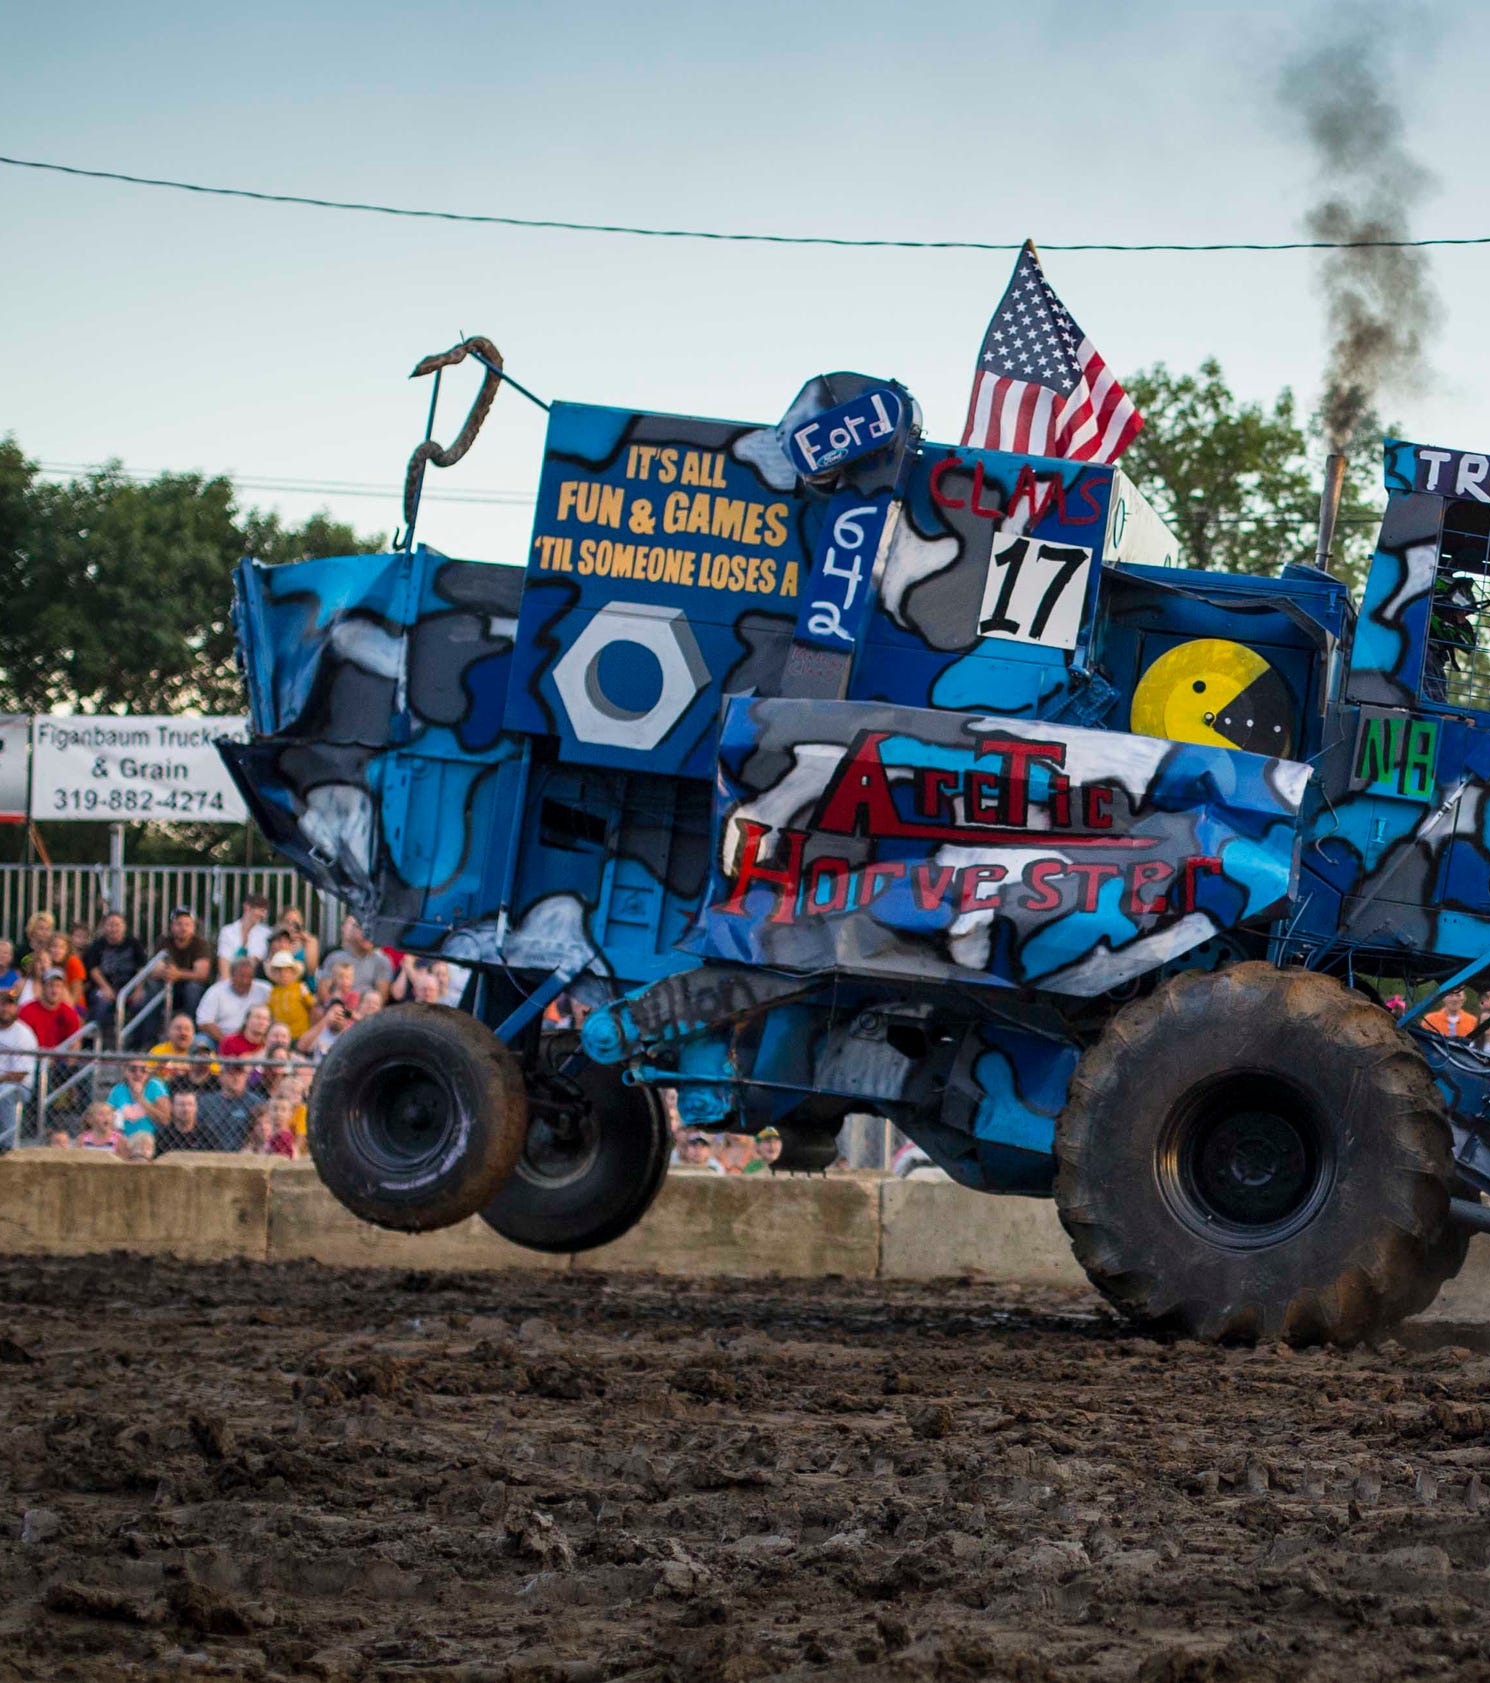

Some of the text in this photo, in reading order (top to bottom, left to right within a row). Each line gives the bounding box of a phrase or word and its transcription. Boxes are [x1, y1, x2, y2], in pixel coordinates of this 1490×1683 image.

[794, 393, 894, 471] Ford
[626, 445, 727, 488] IT'S ALL
[930, 457, 1111, 528] CLAAS
[556, 480, 789, 547] FUN & GAMES
[577, 538, 696, 587] SOMEONE
[697, 552, 776, 594] LOSES
[780, 561, 799, 597] A
[979, 537, 1090, 641] 17
[53, 787, 225, 812] 319-882-4274
[92, 756, 189, 780] & Grain
